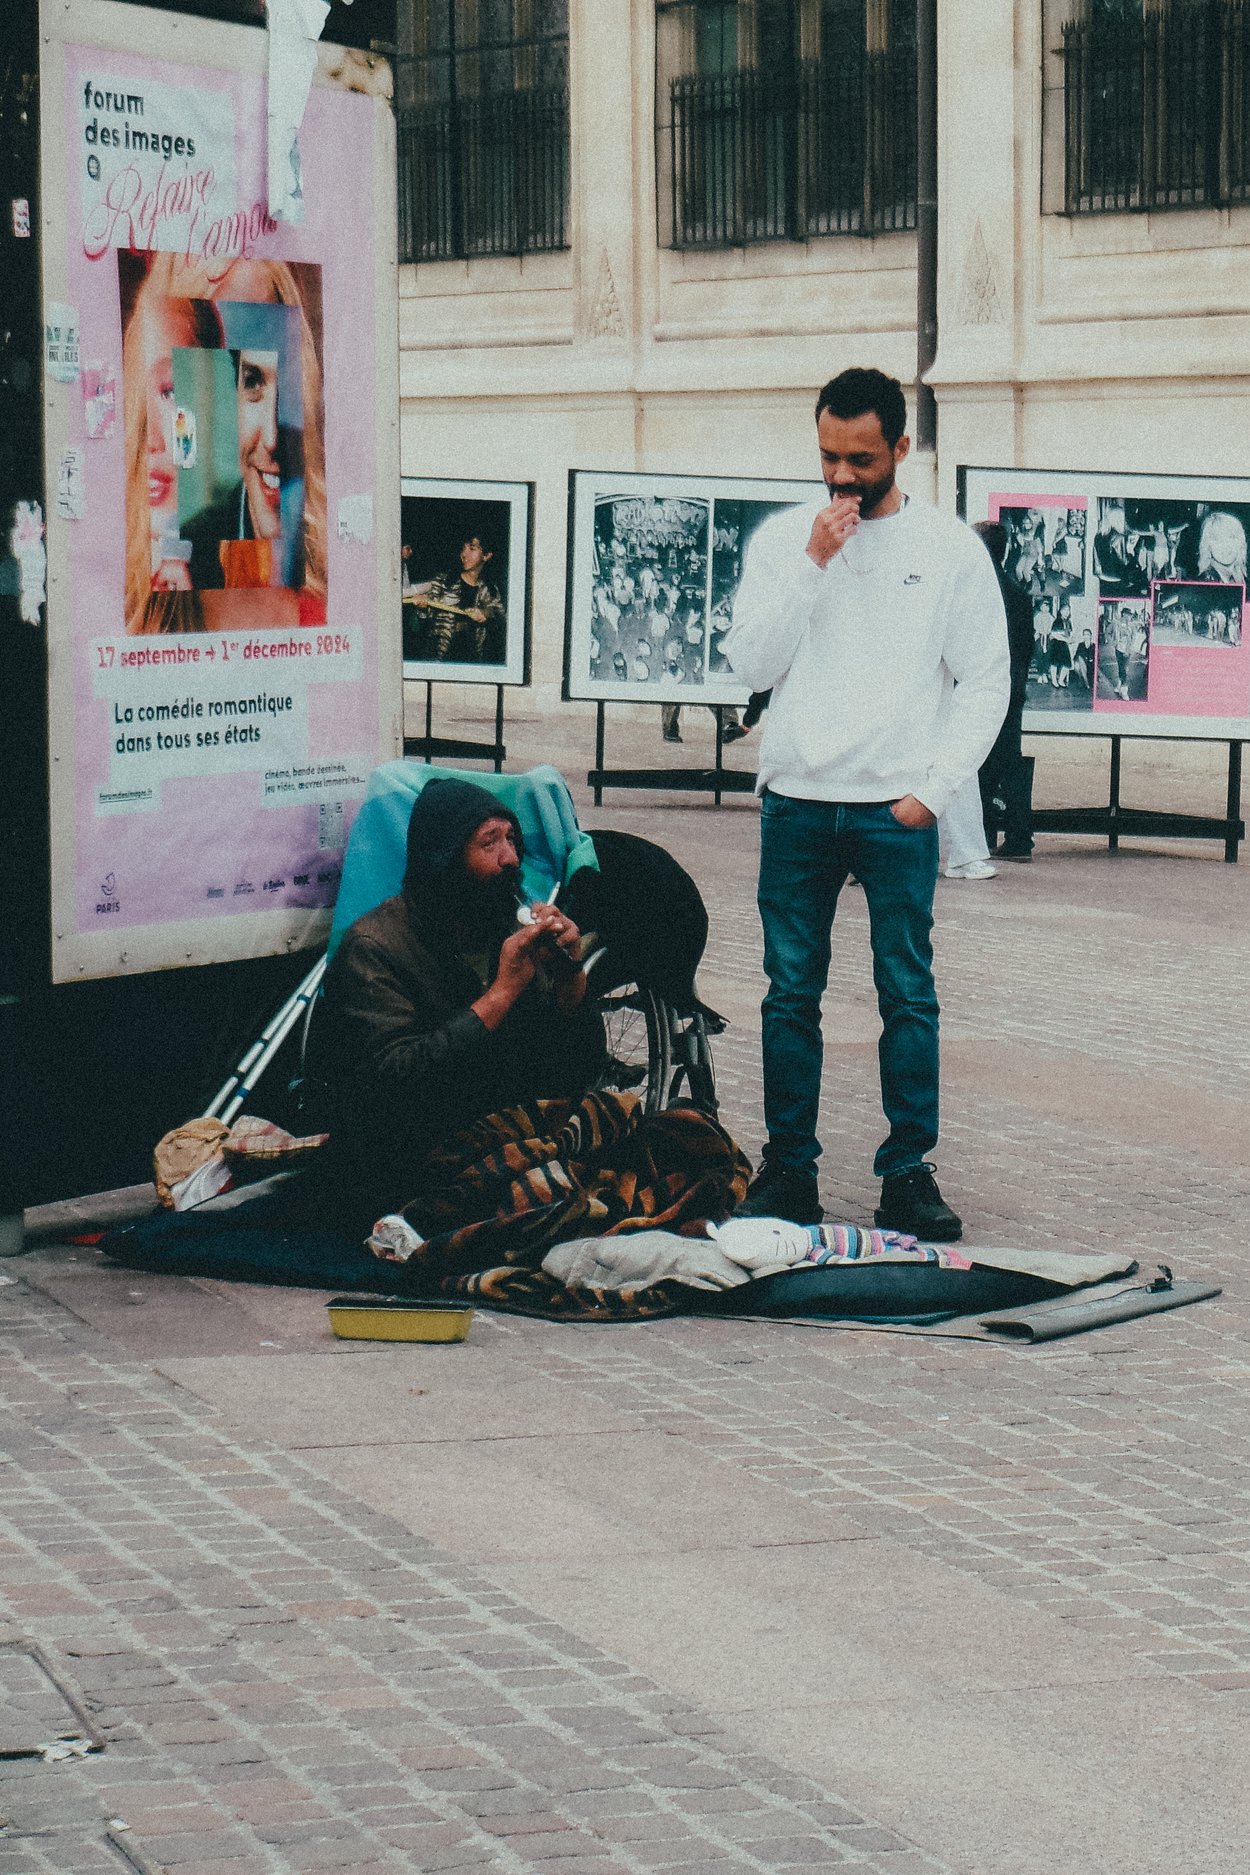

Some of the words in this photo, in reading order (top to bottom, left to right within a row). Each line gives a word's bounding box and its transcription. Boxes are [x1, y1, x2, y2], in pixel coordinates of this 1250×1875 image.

[84, 81, 144, 116] forum
[85, 118, 120, 148] des
[125, 121, 196, 161] images
[97, 646, 115, 668] 17
[121, 641, 200, 672] septembre
[243, 638, 313, 661] décembre
[316, 634, 350, 656] 2024
[115, 702, 133, 724] La
[138, 697, 203, 722] comédie
[208, 692, 293, 718] romantique
[116, 732, 152, 754] dans
[157, 731, 191, 751] tous
[196, 731, 220, 748] ses
[225, 724, 261, 745] états
[96, 901, 120, 914] PARIS
